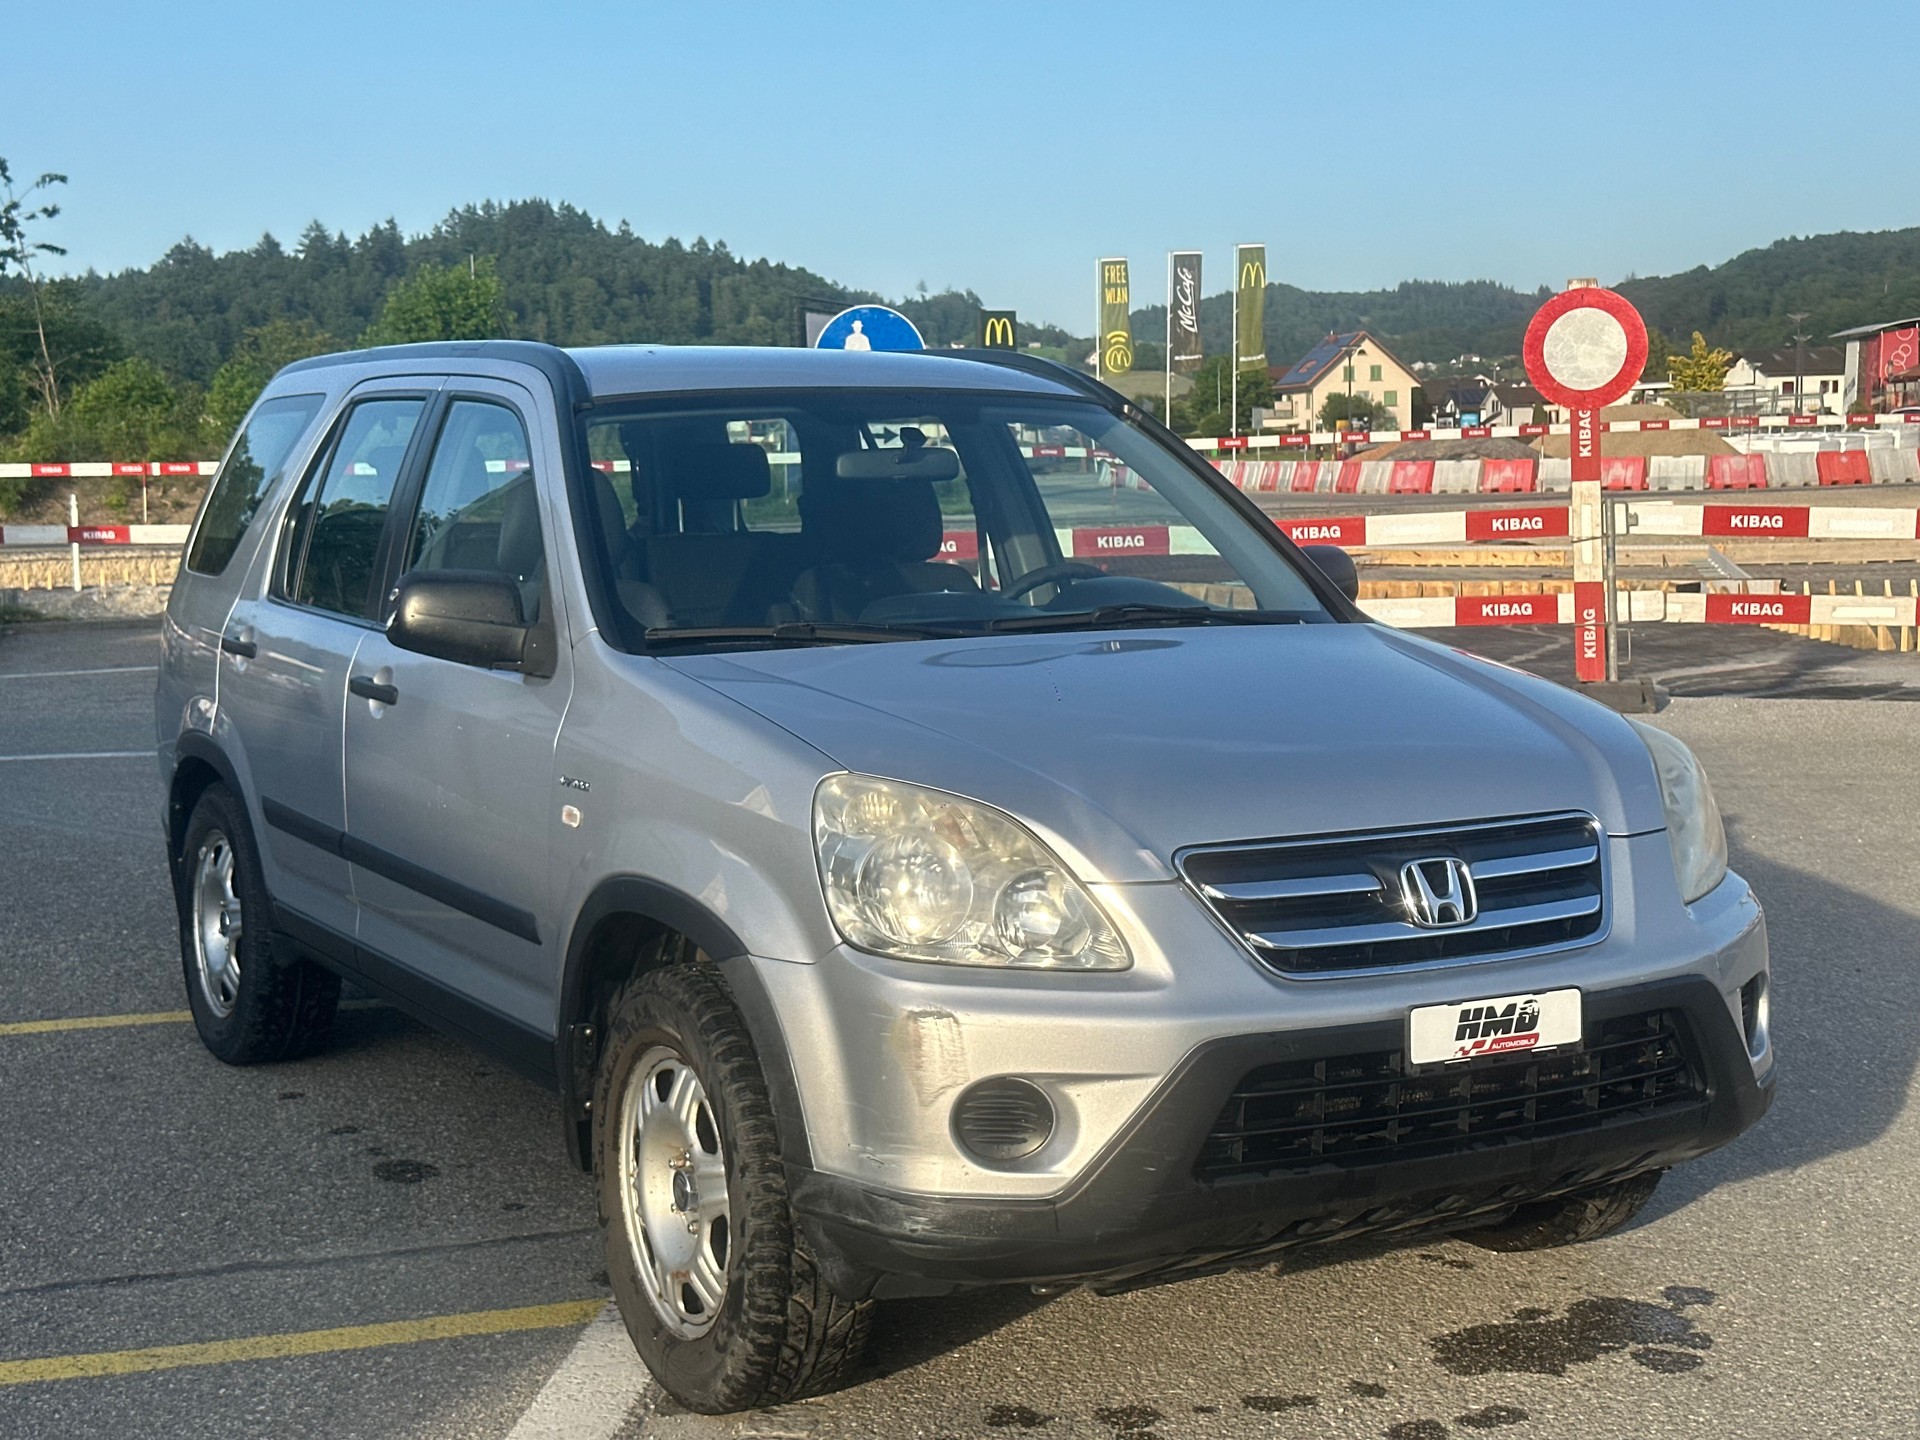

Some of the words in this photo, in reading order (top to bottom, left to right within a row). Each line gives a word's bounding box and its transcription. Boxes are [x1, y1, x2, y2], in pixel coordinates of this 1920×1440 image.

[1105, 264, 1127, 284] FREE
[1105, 287, 1128, 304] WLAN
[1578, 409, 1592, 458] KIBAG
[1492, 516, 1543, 532] KIBAG
[1731, 514, 1783, 529] KIBAG
[83, 530, 116, 540] KIBAG
[1291, 525, 1341, 540] KIBAG
[1097, 534, 1145, 549] KIBAG
[1481, 602, 1533, 617] KIBAG
[1731, 602, 1784, 616] KIBAG
[1583, 607, 1597, 659] KIBAG
[1491, 1038, 1536, 1050] AUTOMOBILE
